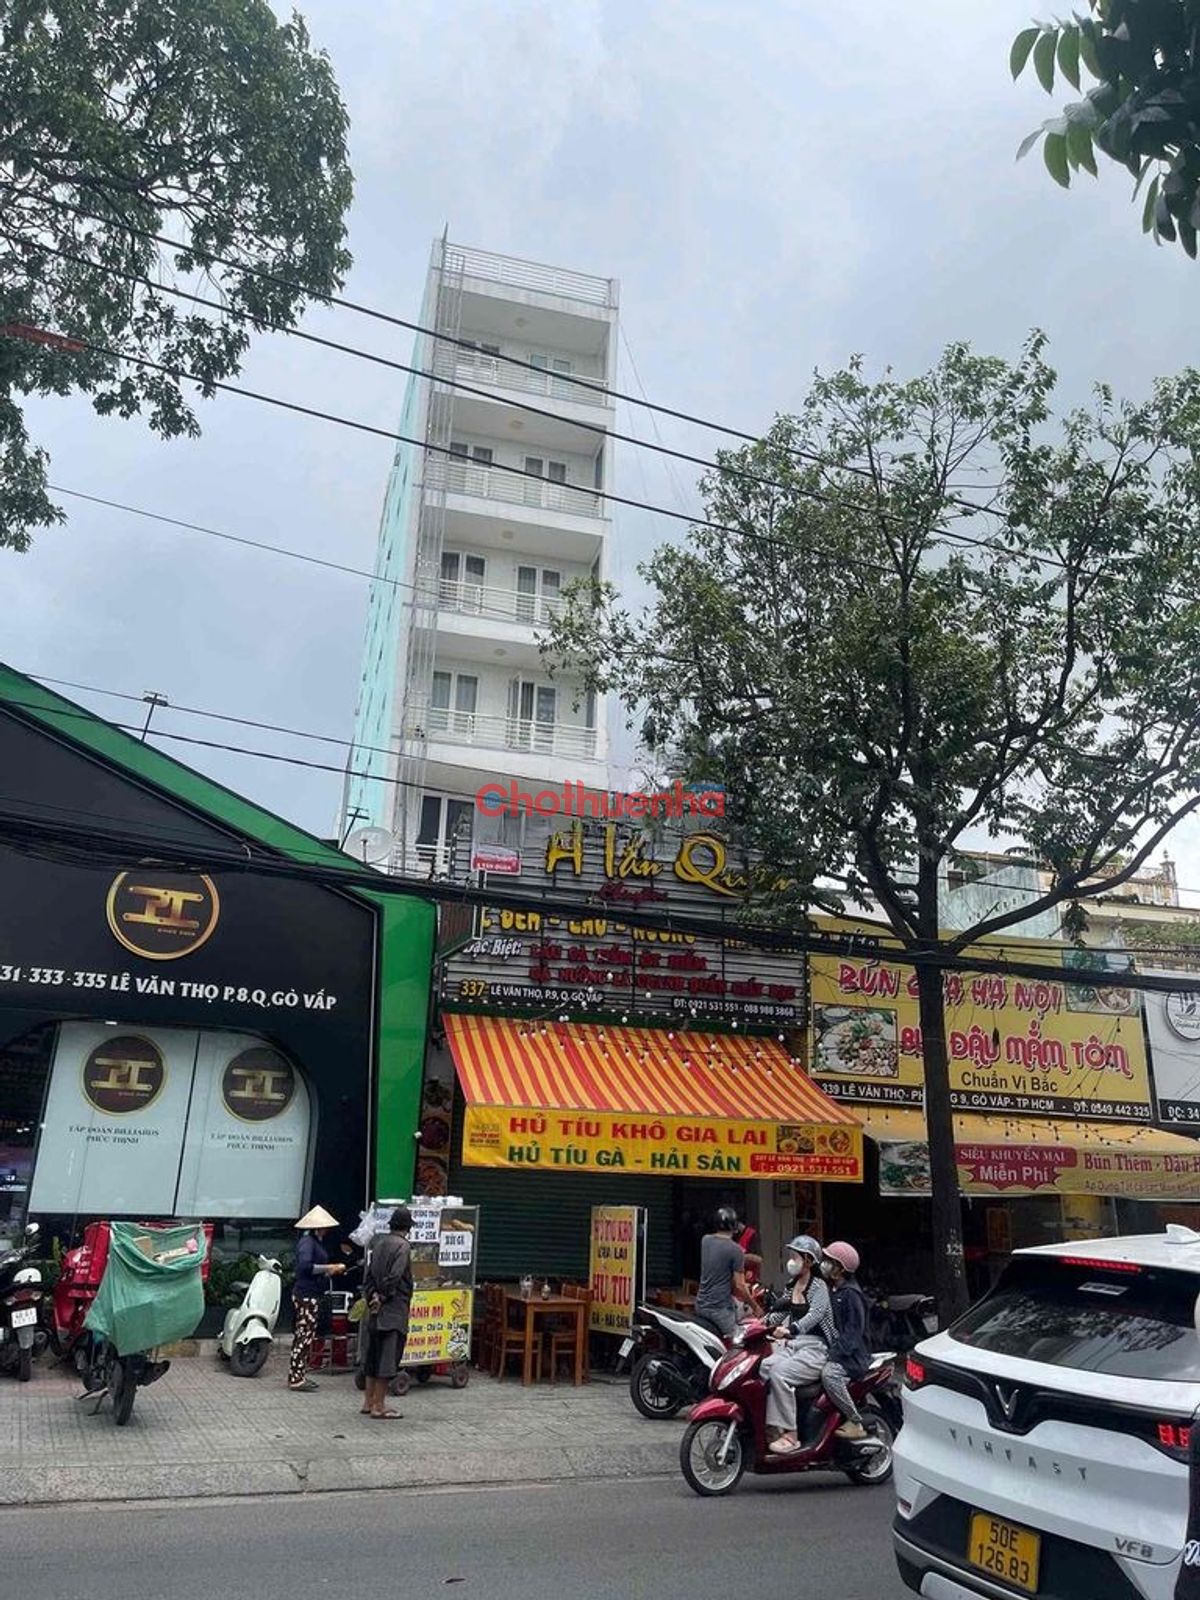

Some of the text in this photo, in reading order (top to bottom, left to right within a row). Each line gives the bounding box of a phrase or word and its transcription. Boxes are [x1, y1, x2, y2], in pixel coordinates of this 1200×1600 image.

[110, 972, 131, 992] LÊ
[136, 975, 175, 996] VĂN
[180, 982, 219, 1004] THỌ
[303, 988, 337, 1010] VẤP
[839, 957, 901, 999] BÚN
[949, 1024, 1000, 1068] ĐẬU
[1070, 1034, 1134, 1079] TÔM
[842, 1083, 856, 1097] LÊ
[858, 1084, 881, 1098] VĂN
[961, 1070, 1058, 1094] Chuẩn Vị Bắc
[510, 1112, 768, 1146] HỦ TÍU KHÔ GIA LAI
[508, 1140, 540, 1164] HỦ
[551, 1144, 587, 1165] TÍU
[595, 1146, 625, 1167] GÀ
[651, 1147, 688, 1169] HẢI
[697, 1150, 741, 1172] SẢN
[960, 1147, 987, 1161] SIÊU
[980, 1163, 1049, 1182] Miễn Phí
[990, 1521, 1019, 1554] 50E
[978, 1543, 1030, 1585] 126.83
